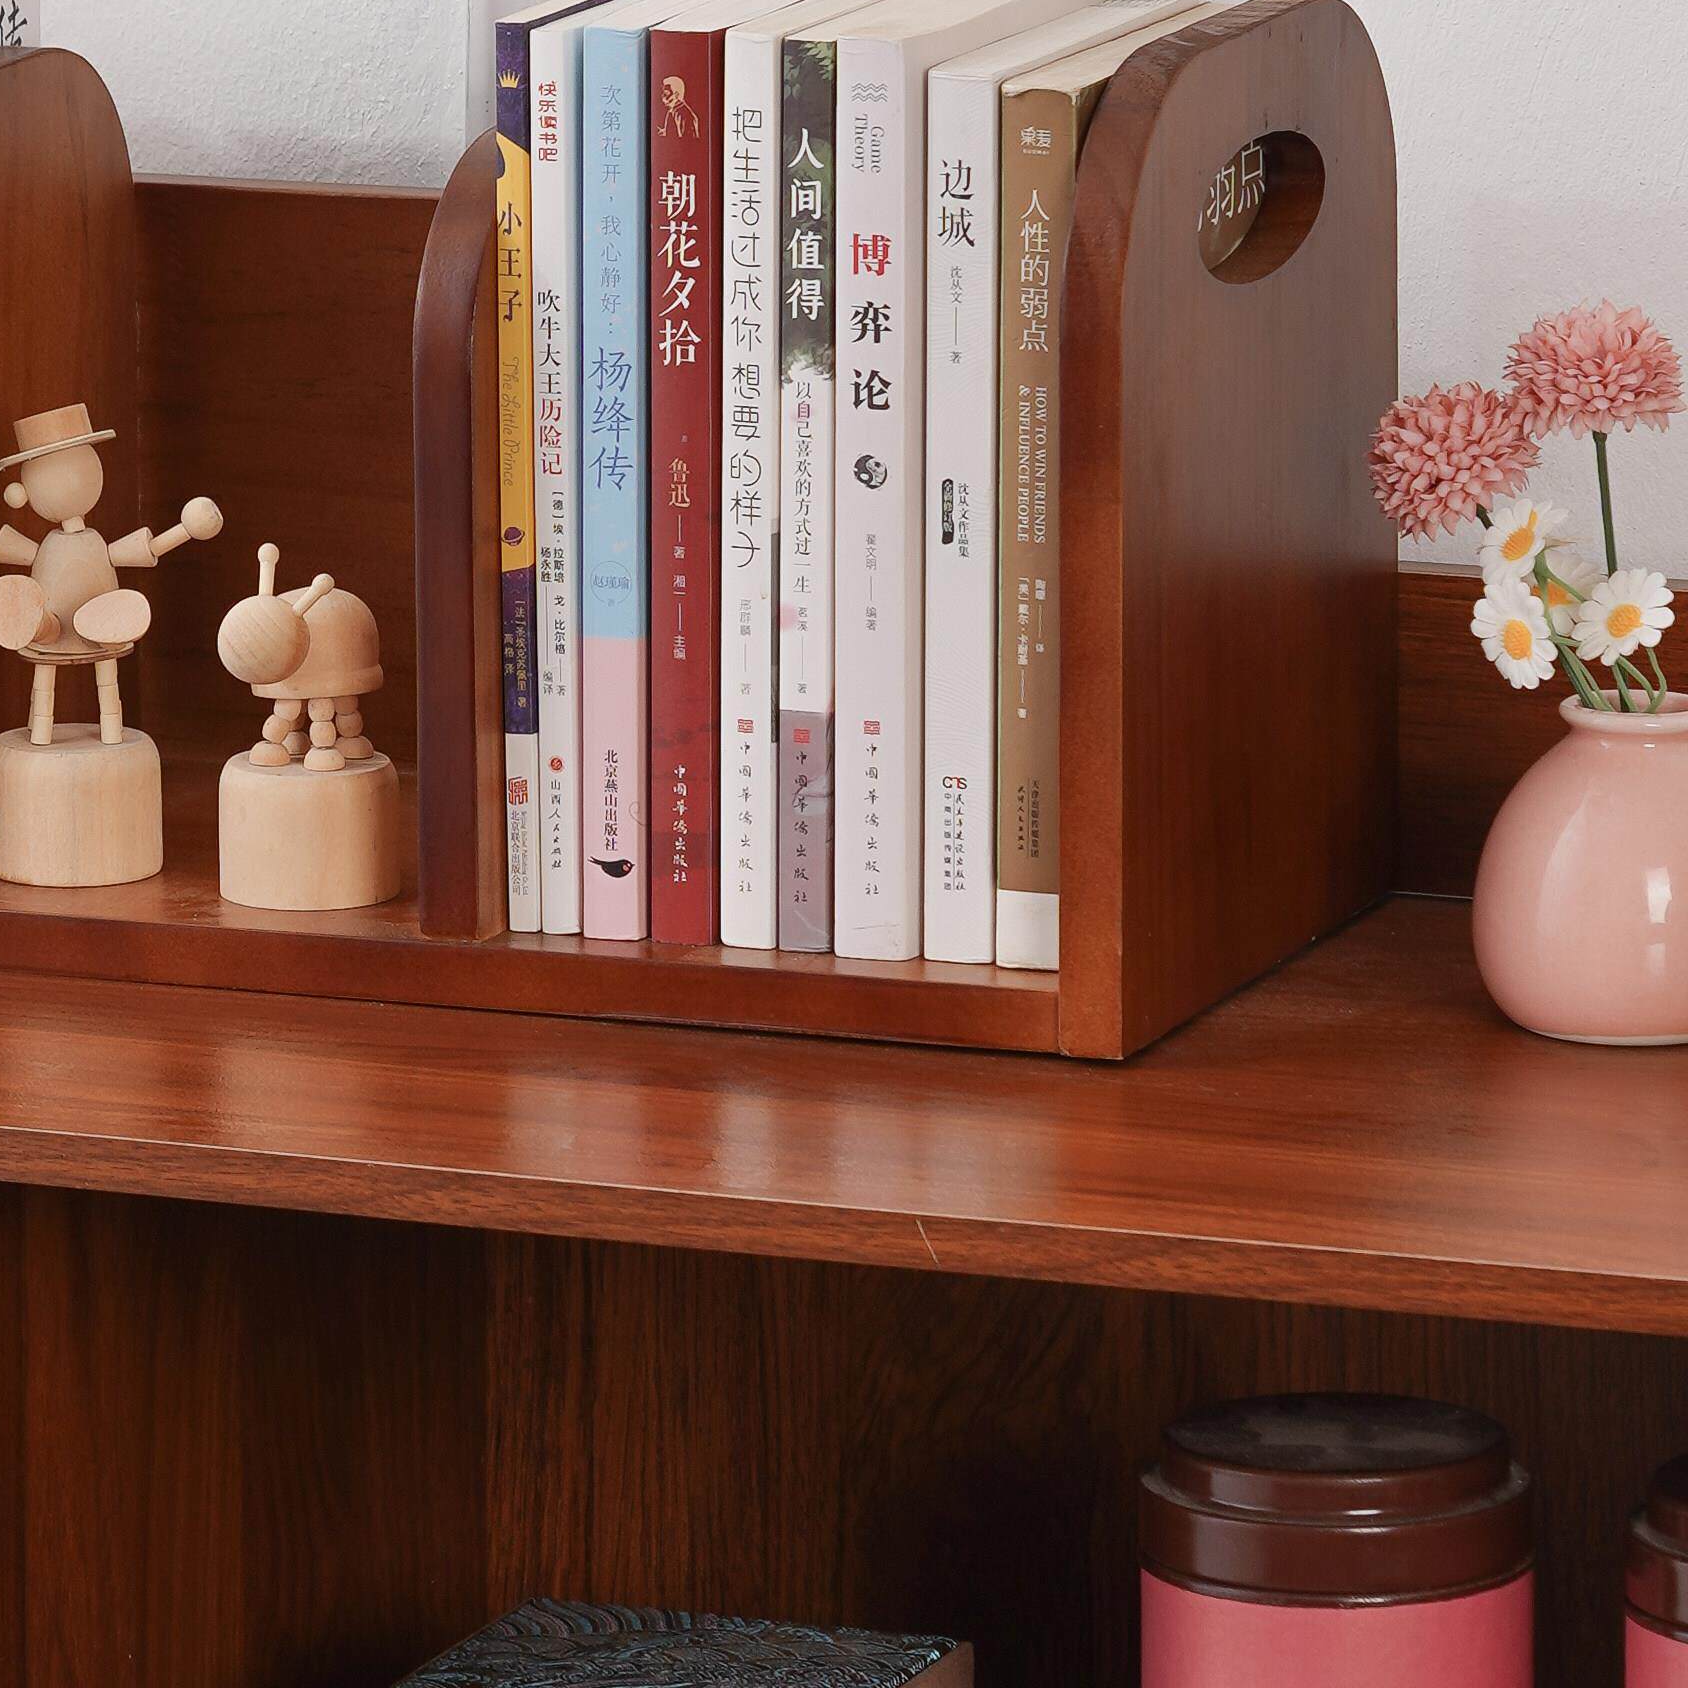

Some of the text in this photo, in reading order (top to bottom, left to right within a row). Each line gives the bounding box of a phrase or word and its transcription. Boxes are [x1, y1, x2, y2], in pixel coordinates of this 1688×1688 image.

[538, 81, 558, 162] 快乐读书吧
[852, 114, 868, 172] Theory
[870, 126, 885, 174] Game
[498, 202, 522, 322] 小王子
[657, 171, 702, 366] 朝花夕拾
[785, 128, 825, 321] 人间值得
[937, 159, 975, 248] 边城
[1020, 189, 1050, 352] 人性的弱点
[730, 107, 763, 568] 把生活过成你想要的样子
[850, 233, 892, 410] 博弈论
[951, 266, 962, 304] 沈从文
[538, 289, 563, 476] 吹牛大王历险记
[588, 347, 634, 491] 杨绛传
[1018, 384, 1031, 396] &
[669, 457, 690, 508] 鲁迅
[793, 381, 812, 594] 以自己喜欢的方式过一生
[957, 482, 969, 558] 沈从文作品集
[1034, 386, 1047, 544] HOW TO WIN FRIENDS
[605, 749, 618, 852] 北京燕山出版社
[673, 764, 687, 883] 中国华侨出版社
[738, 742, 752, 893] 中国华侨出版社
[794, 752, 809, 903] 中国华侨出版社
[865, 744, 880, 895] 中国华侨出版社
